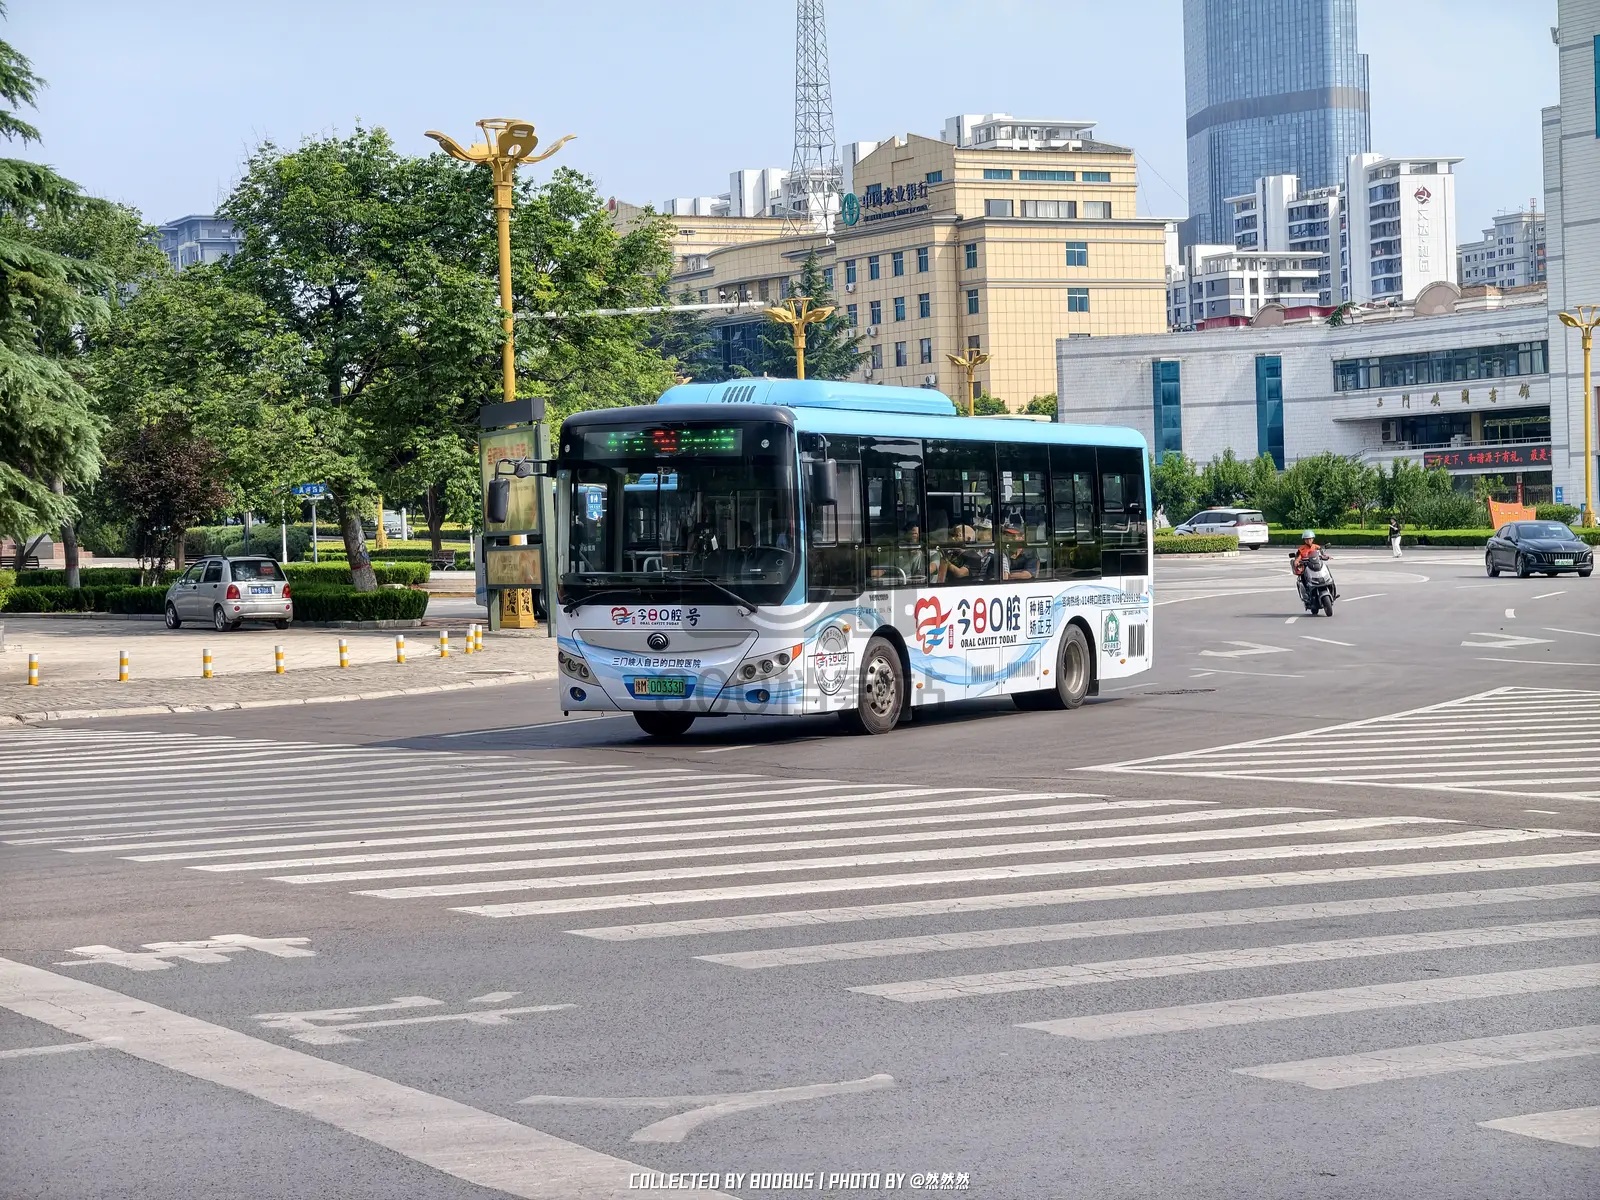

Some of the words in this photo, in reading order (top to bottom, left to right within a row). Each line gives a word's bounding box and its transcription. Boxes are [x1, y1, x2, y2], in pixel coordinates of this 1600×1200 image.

[862, 180, 928, 209] 中国农业银行
[958, 595, 1021, 635] 今日口腔
[1029, 600, 1052, 617] 种植牙
[1029, 619, 1052, 635] 矫正牙
[961, 638, 976, 648] ORAL
[978, 636, 997, 646] CAVITY
[999, 634, 1018, 644] TODAY
[612, 657, 702, 668] 三门峡人自己的口腔医院
